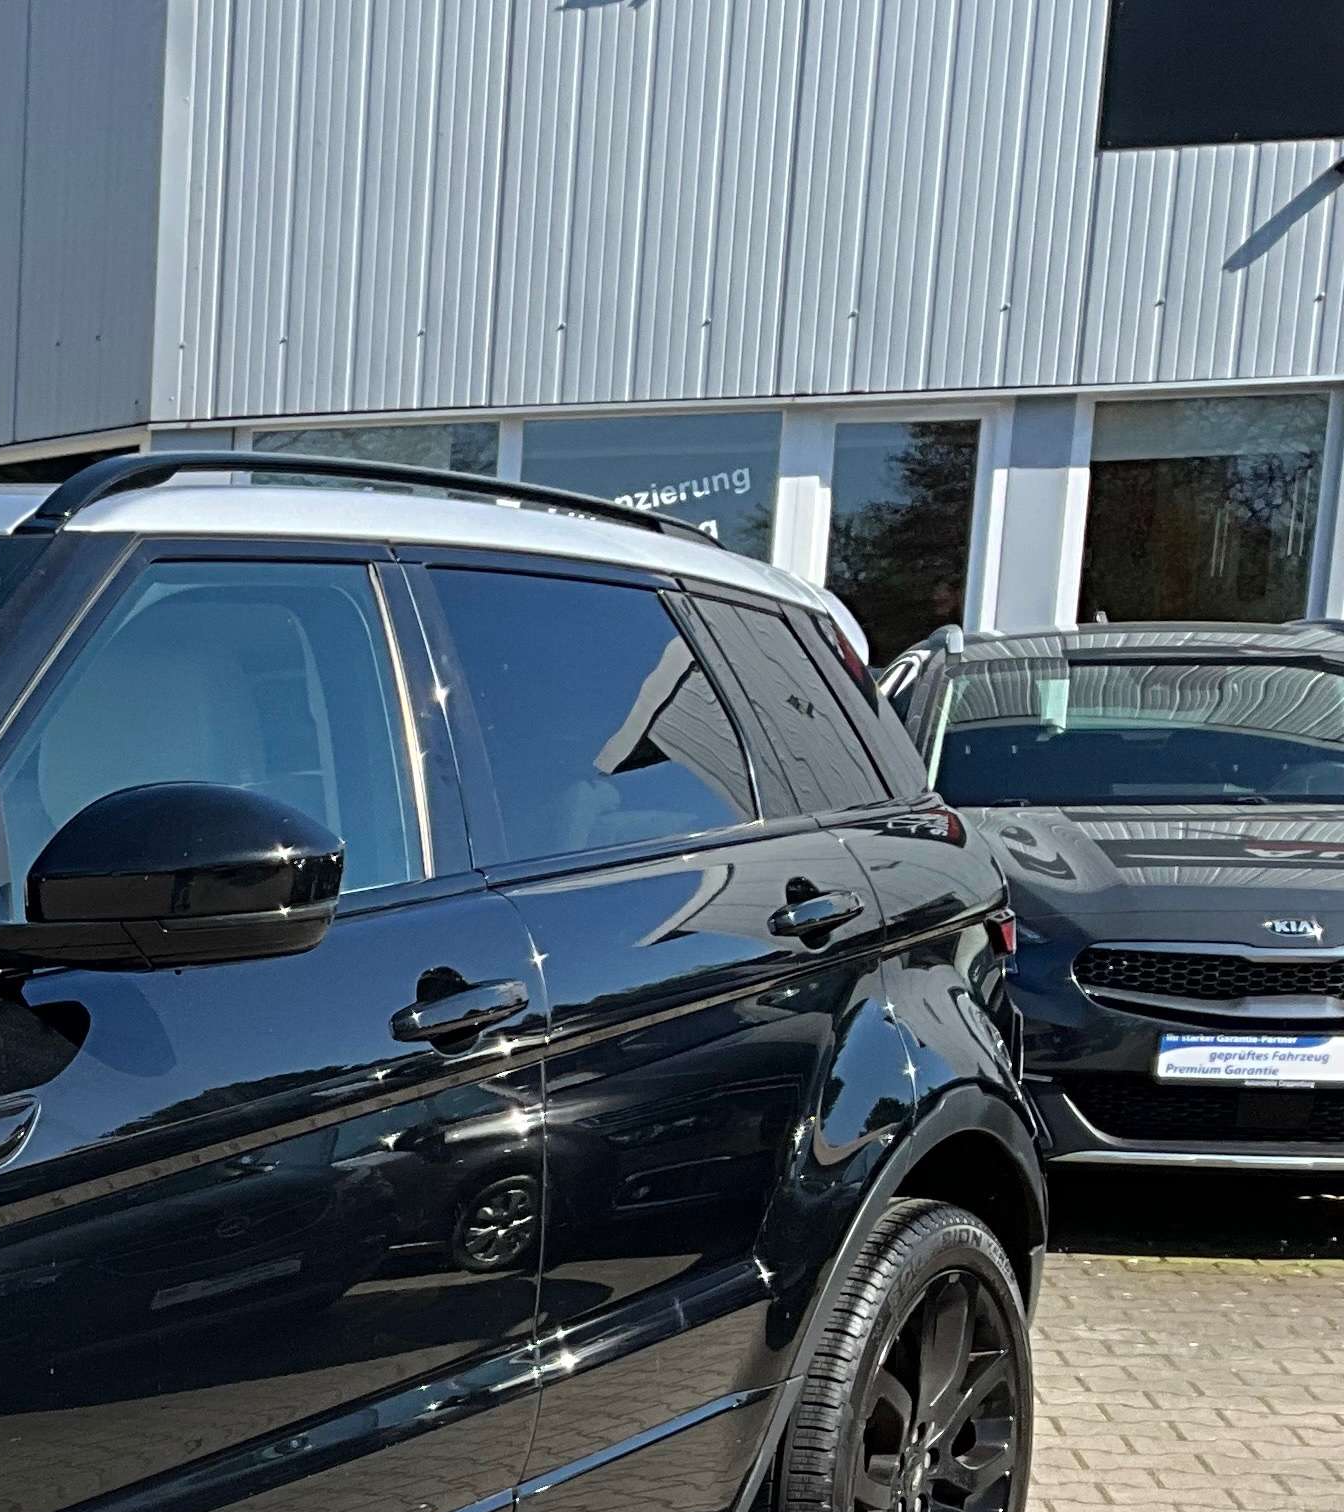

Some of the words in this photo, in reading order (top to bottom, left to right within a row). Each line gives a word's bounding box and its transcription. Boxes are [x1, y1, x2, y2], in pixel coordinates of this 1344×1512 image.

[1273, 919, 1313, 933] KIA
[1209, 1049, 1269, 1062] geprüftes
[1271, 1051, 1330, 1064] Fahrzeug
[1165, 1063, 1221, 1075] Premium
[1224, 1065, 1280, 1076] Garantie
